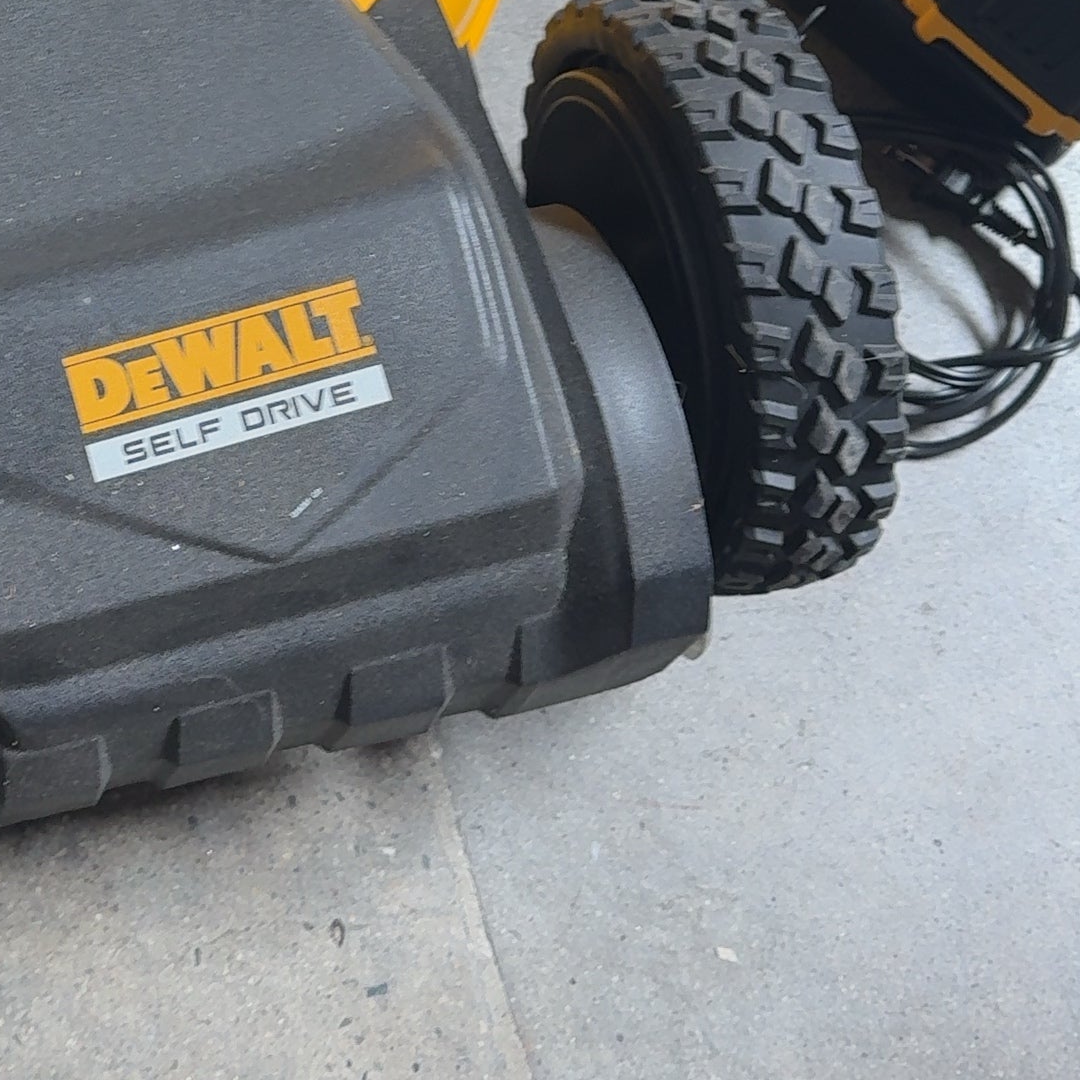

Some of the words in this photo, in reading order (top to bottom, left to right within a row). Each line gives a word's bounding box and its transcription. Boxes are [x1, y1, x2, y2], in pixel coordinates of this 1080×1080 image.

[64, 287, 364, 426] DEWALT
[122, 416, 221, 465] SELF
[239, 380, 356, 432] DRIVE
